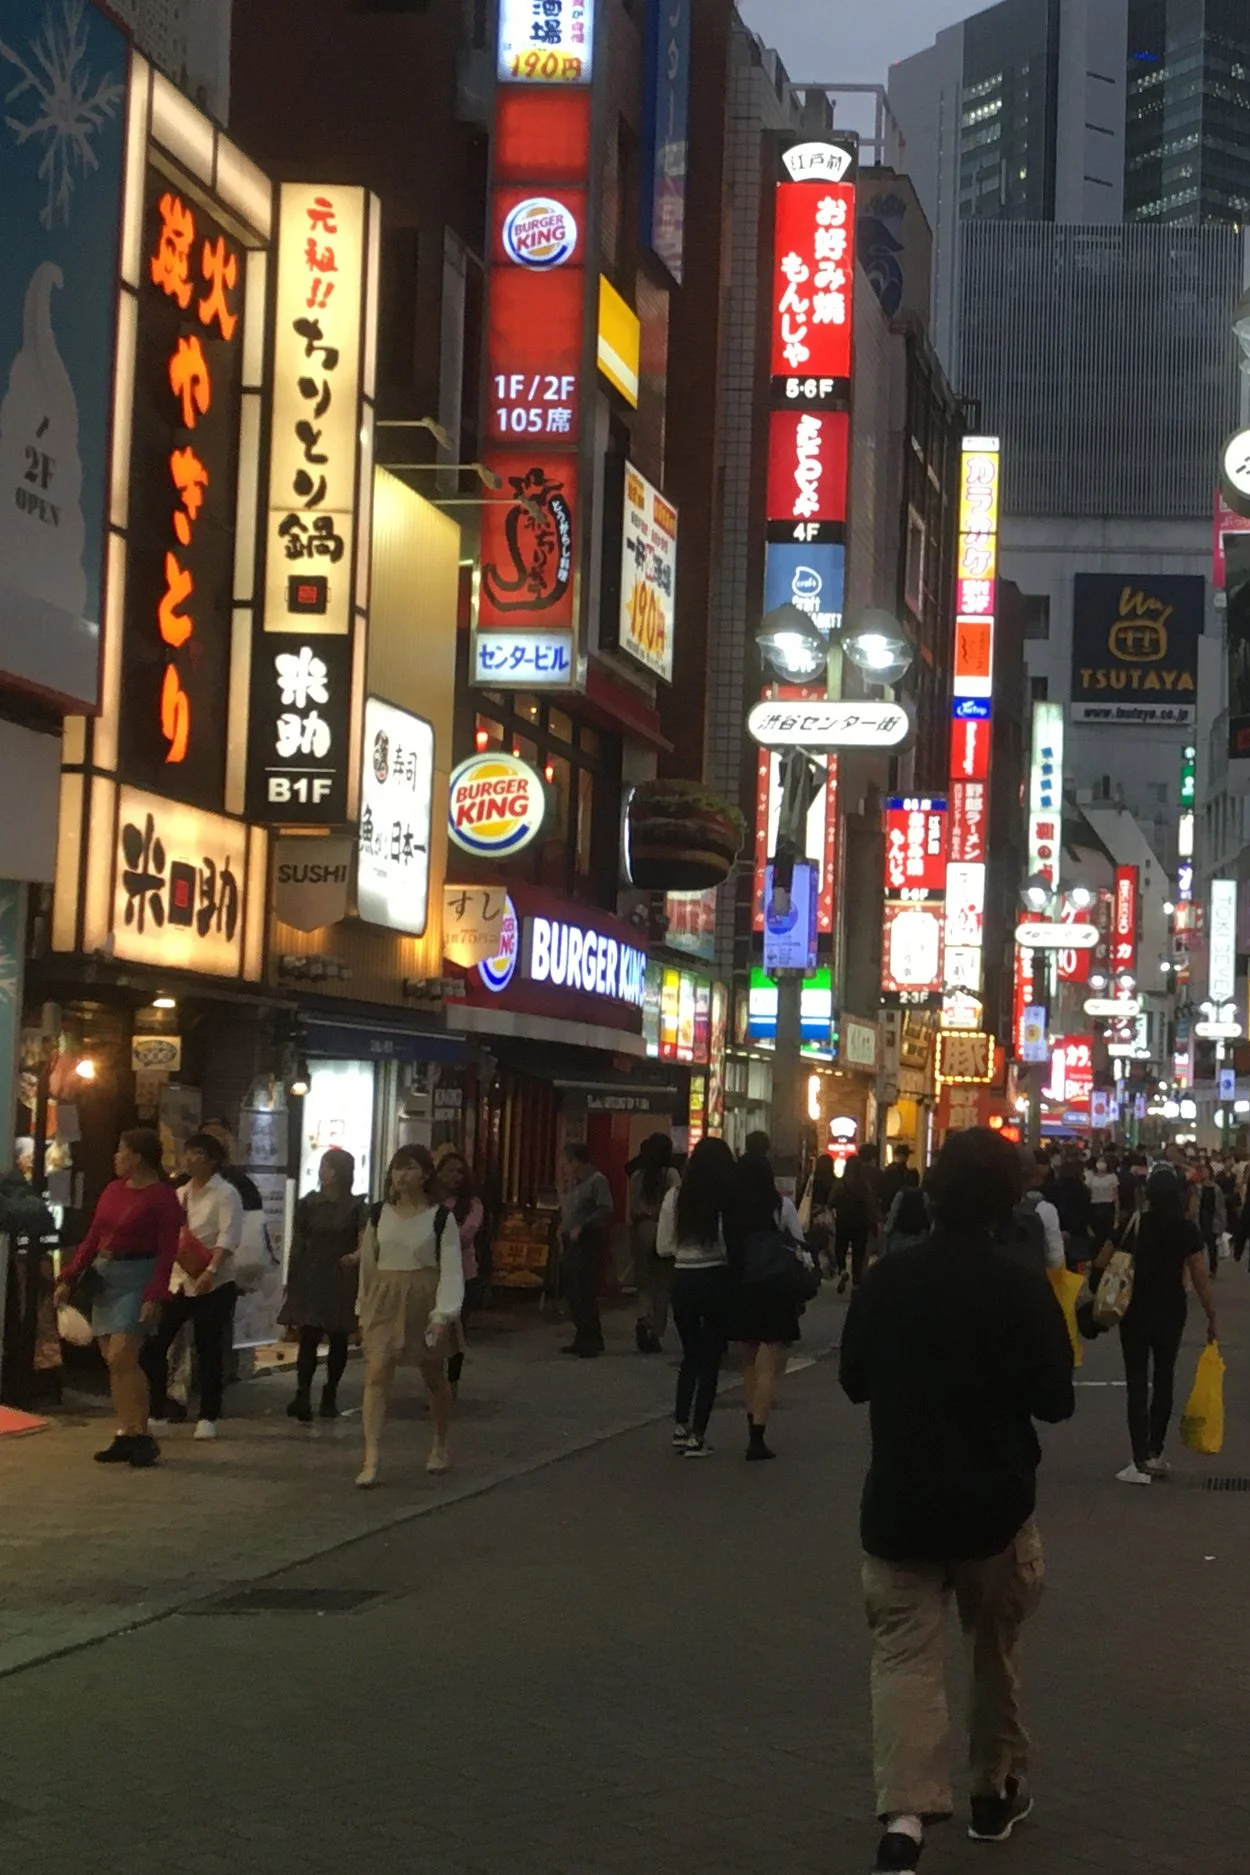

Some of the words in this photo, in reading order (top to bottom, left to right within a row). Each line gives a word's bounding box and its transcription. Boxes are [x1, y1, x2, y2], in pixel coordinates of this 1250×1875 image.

[514, 212, 564, 236] BURGER
[516, 226, 566, 253] KING
[812, 196, 847, 325] お好み焼
[779, 252, 809, 368] もんじゃ
[497, 406, 572, 432] 105席
[24, 446, 56, 490] 2F
[15, 488, 62, 531] OPEN
[793, 522, 821, 543] 4F
[479, 643, 569, 671] センタービル
[1079, 668, 1196, 691] TSUTAYA
[274, 646, 332, 758] 米助
[1083, 706, 1189, 722] www.tsutaya.co.jp
[757, 713, 901, 733] 渋谷センター街
[393, 744, 417, 792] 寿司
[268, 778, 333, 804] B1F
[455, 778, 529, 803] BURGER
[456, 794, 530, 827] KING
[278, 862, 348, 886] SUSHI
[448, 891, 501, 921] すし
[530, 916, 618, 997] BURGER
[618, 944, 648, 1013] KING
